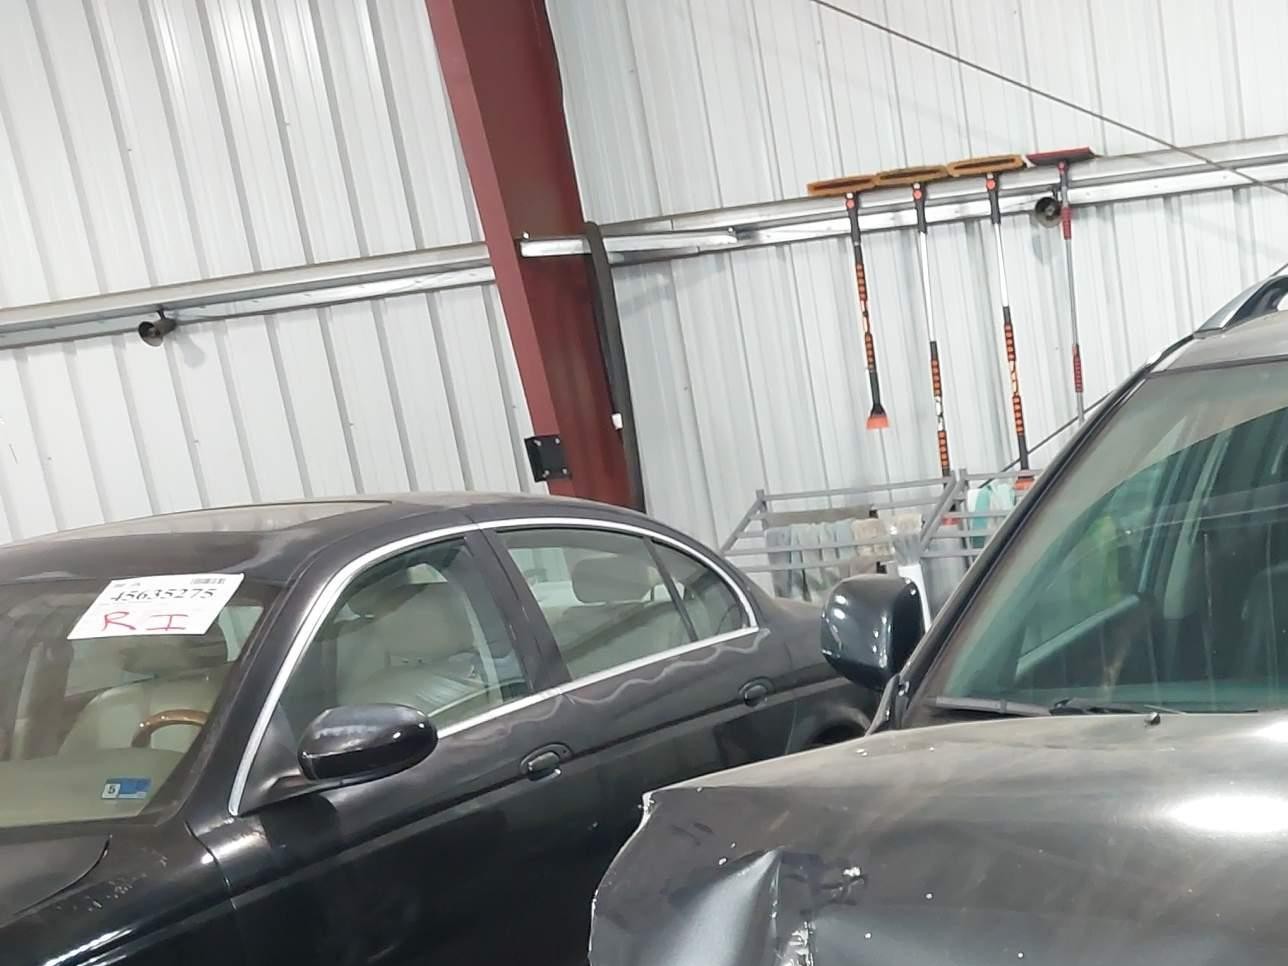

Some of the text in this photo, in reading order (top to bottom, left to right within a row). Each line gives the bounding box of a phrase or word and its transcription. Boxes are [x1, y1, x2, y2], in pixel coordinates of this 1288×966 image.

[110, 588, 217, 602] 45635275
[101, 611, 189, 631] R I
